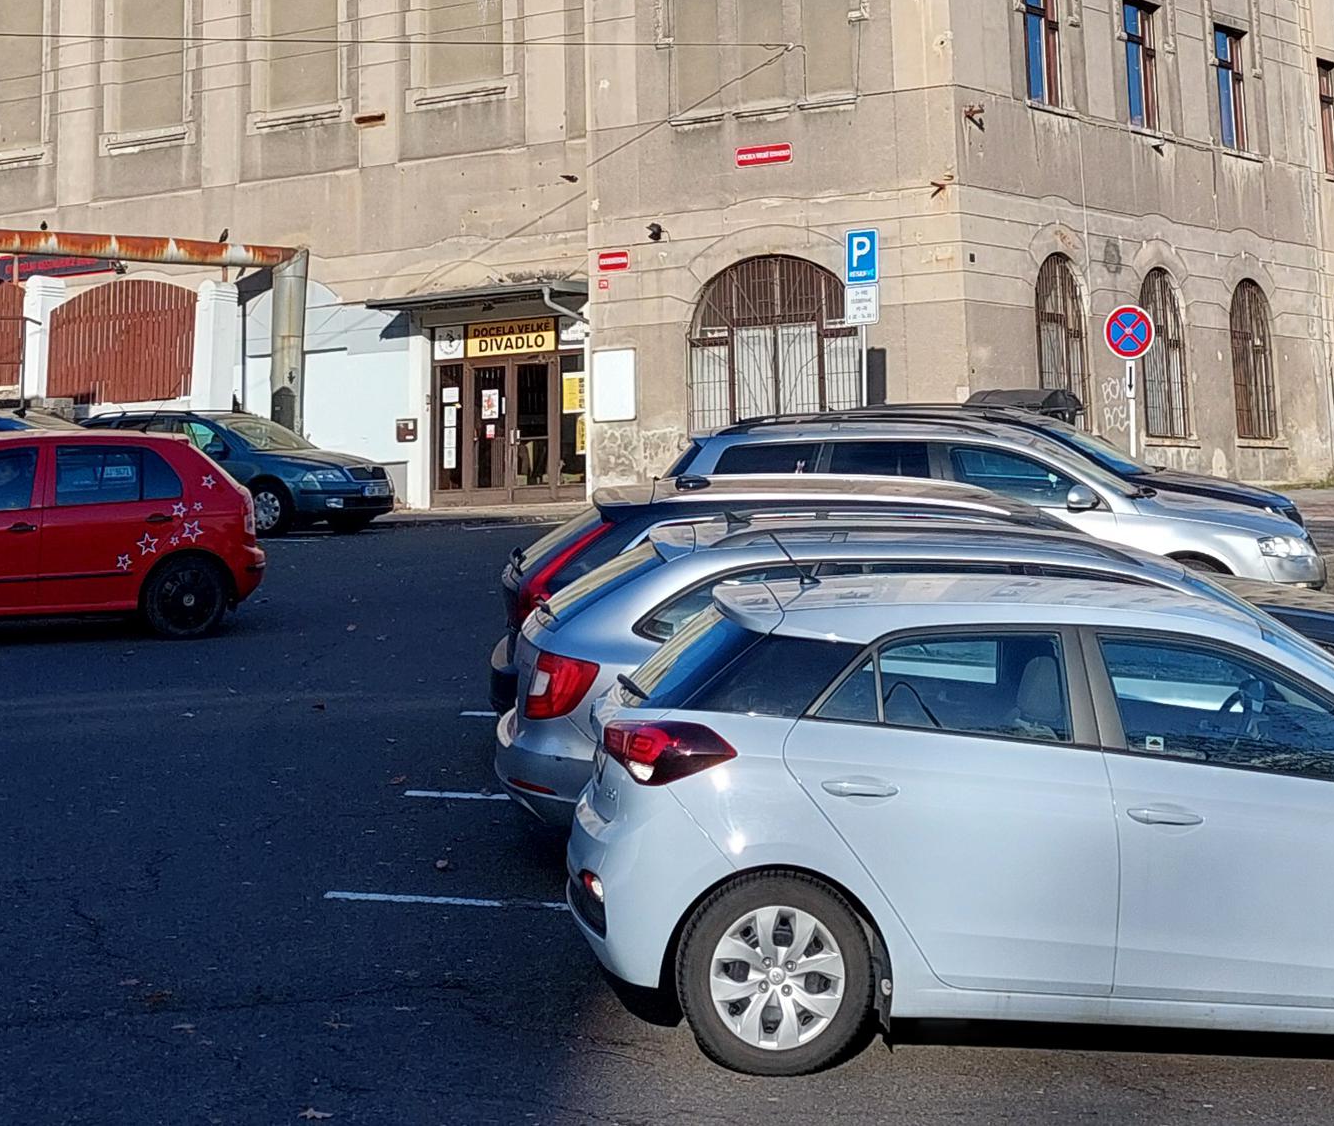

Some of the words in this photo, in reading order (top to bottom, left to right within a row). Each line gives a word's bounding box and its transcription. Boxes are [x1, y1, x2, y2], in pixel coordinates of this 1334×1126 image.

[473, 325, 516, 338] DOCELA
[517, 319, 551, 334] VELKÉ
[478, 333, 546, 353] DIVADLO
